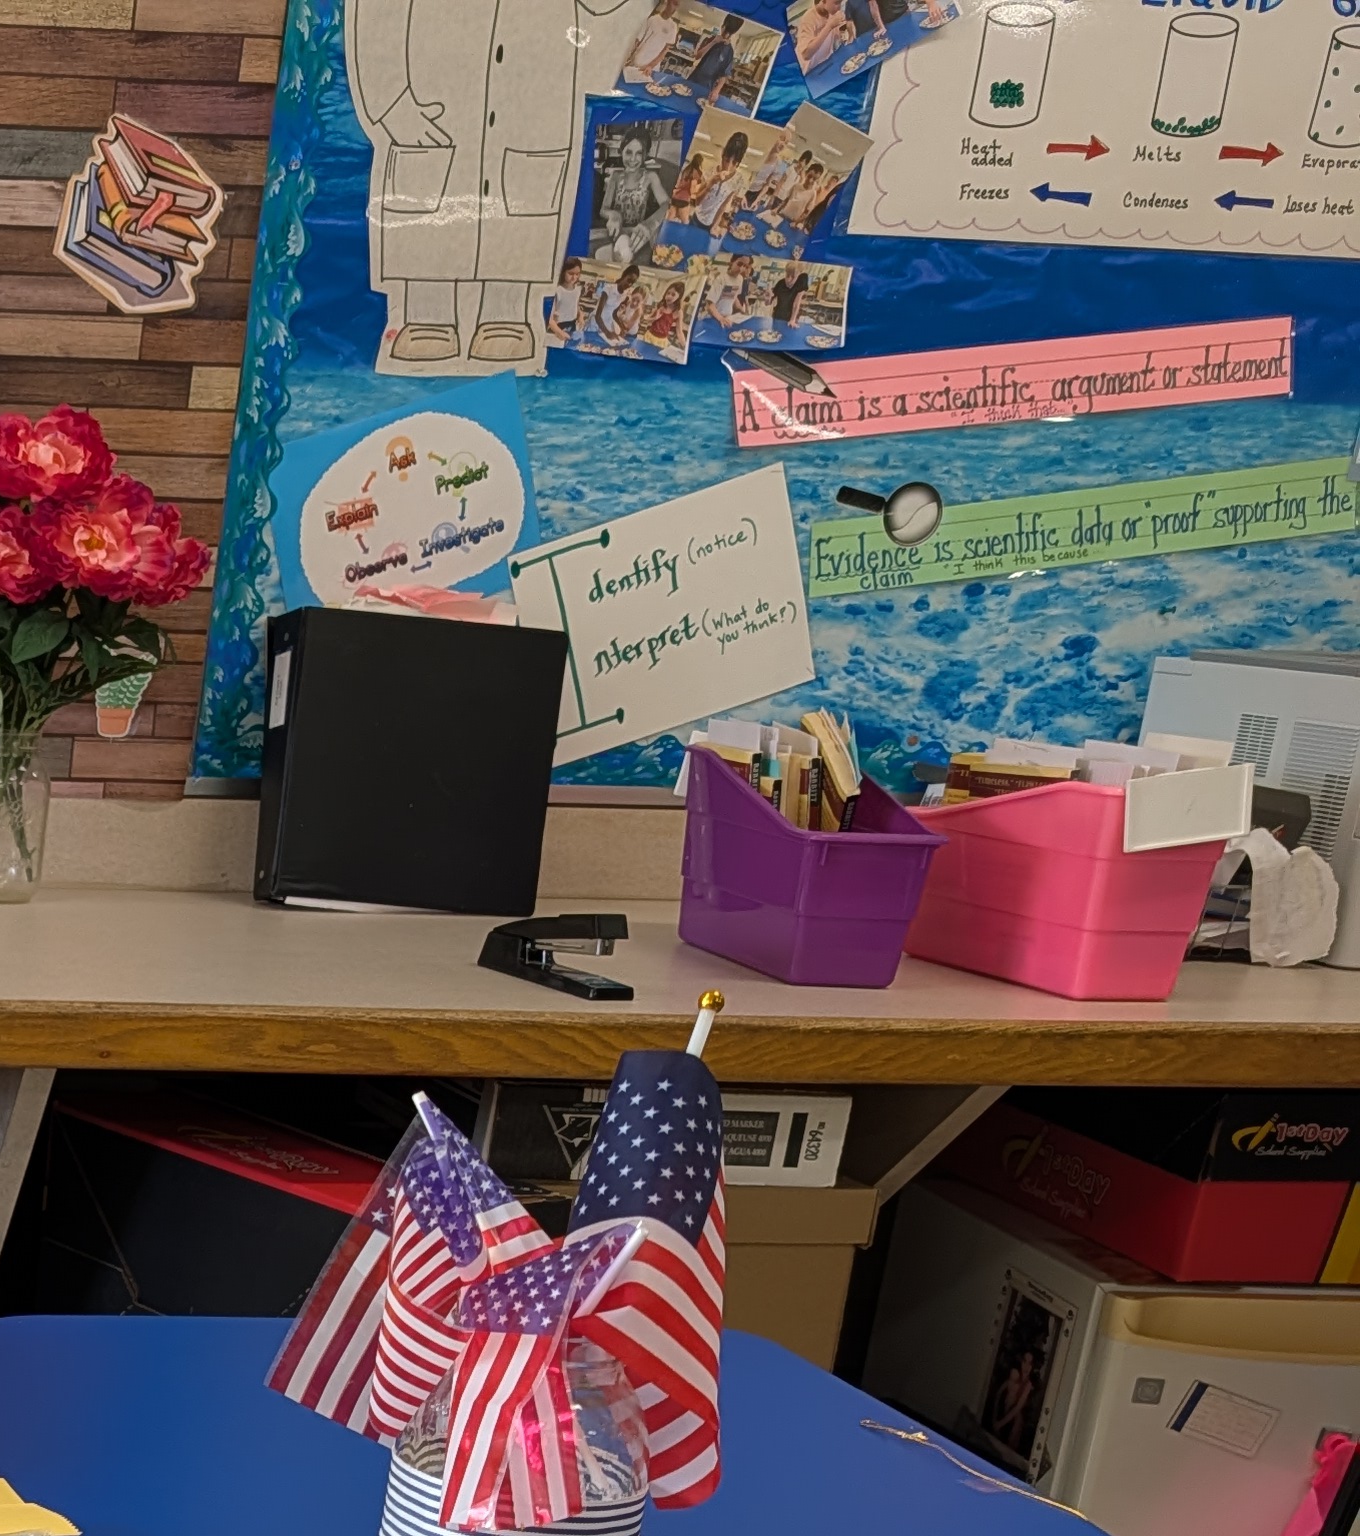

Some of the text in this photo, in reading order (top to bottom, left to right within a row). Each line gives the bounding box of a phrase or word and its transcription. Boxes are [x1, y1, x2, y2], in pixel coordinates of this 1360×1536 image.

[961, 137, 1002, 155] Heat
[971, 153, 1013, 167] added
[1132, 145, 1182, 162] Melts
[959, 183, 1010, 200] Freezes
[1123, 191, 1189, 209] Condenses
[1283, 195, 1355, 215] Loses heat
[740, 390, 760, 432] A
[857, 391, 882, 419] is
[892, 392, 908, 417] a
[919, 367, 1035, 412] scientific
[1051, 352, 1157, 413] argument
[1162, 367, 1183, 388] or
[1186, 338, 1289, 386] statement
[388, 448, 417, 473] Ask
[435, 461, 489, 494] Predict
[325, 501, 379, 532] Explain
[815, 532, 923, 580] Evidence
[934, 532, 954, 563] is
[962, 512, 1059, 561] scientific
[1071, 504, 1113, 547] data
[1122, 515, 1143, 542] or
[1213, 484, 1307, 540] supporting
[1317, 475, 1353, 518] the
[419, 517, 505, 557] Investigate
[687, 517, 758, 565] (notice)
[345, 552, 408, 582] Observe
[860, 569, 913, 591] claim
[702, 605, 748, 637] (What
[755, 598, 770, 615] do
[717, 629, 739, 655] you
[804, 1129, 823, 1161] 64320
